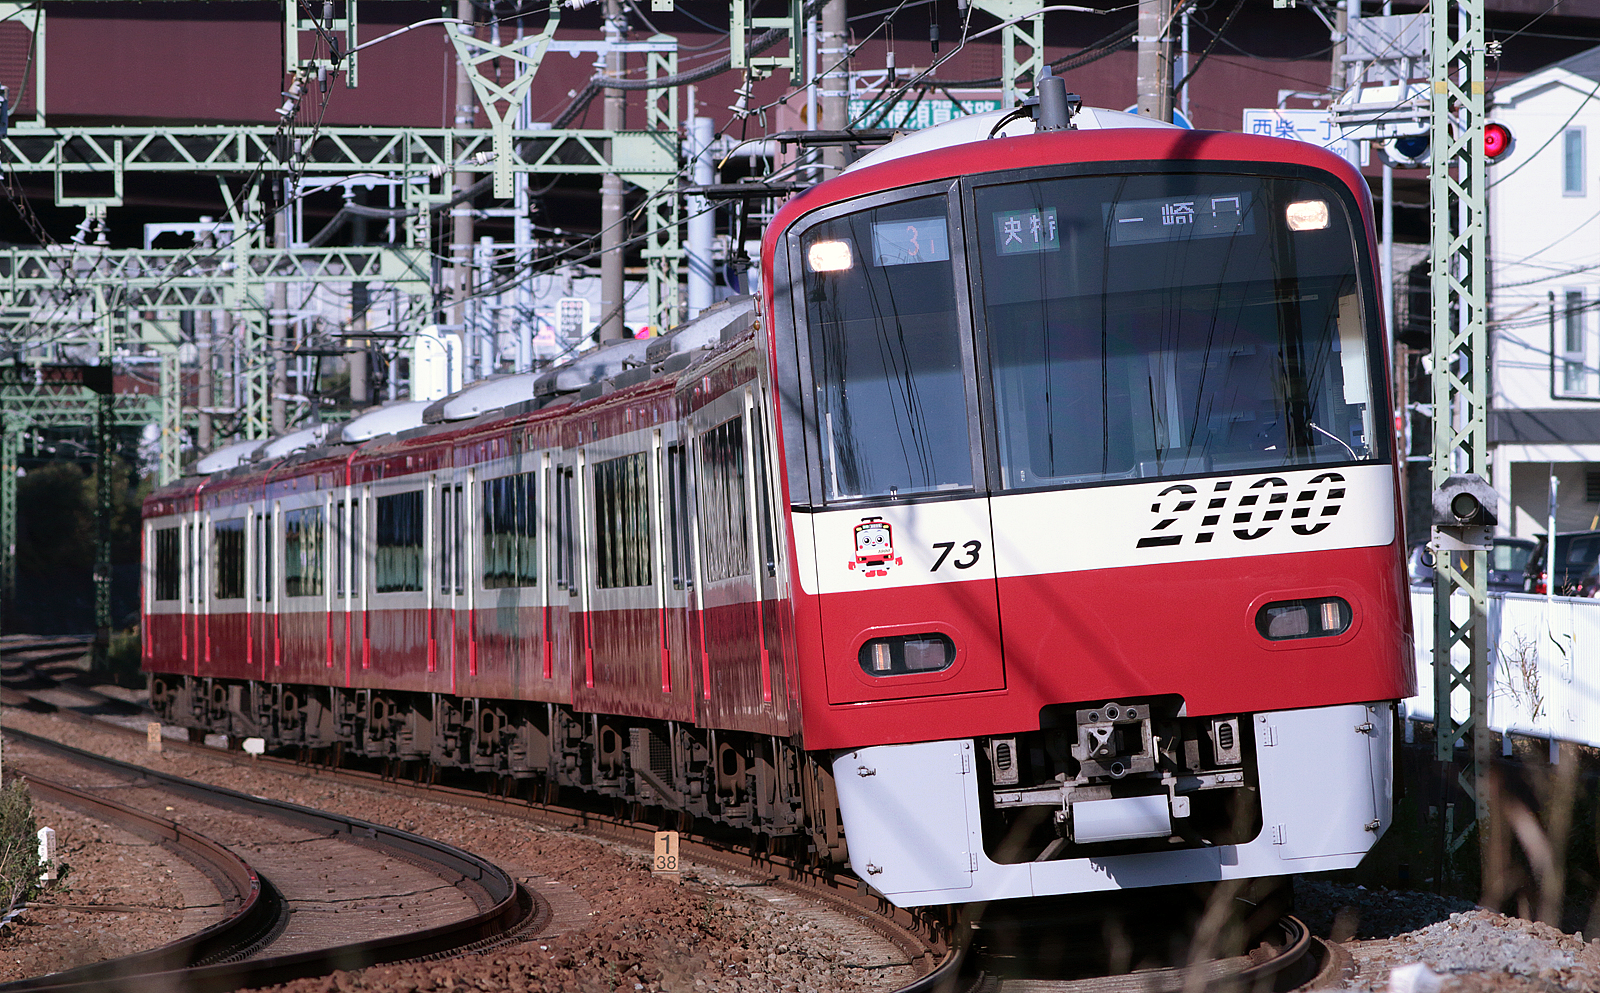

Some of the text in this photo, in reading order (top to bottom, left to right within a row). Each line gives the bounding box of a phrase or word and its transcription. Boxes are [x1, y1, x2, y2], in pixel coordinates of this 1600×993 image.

[1252, 118, 1348, 141] 西柴一丁
[1136, 472, 1346, 549] 2100
[930, 539, 982, 572] 73
[660, 834, 670, 854] 1
[656, 855, 677, 870] 38
